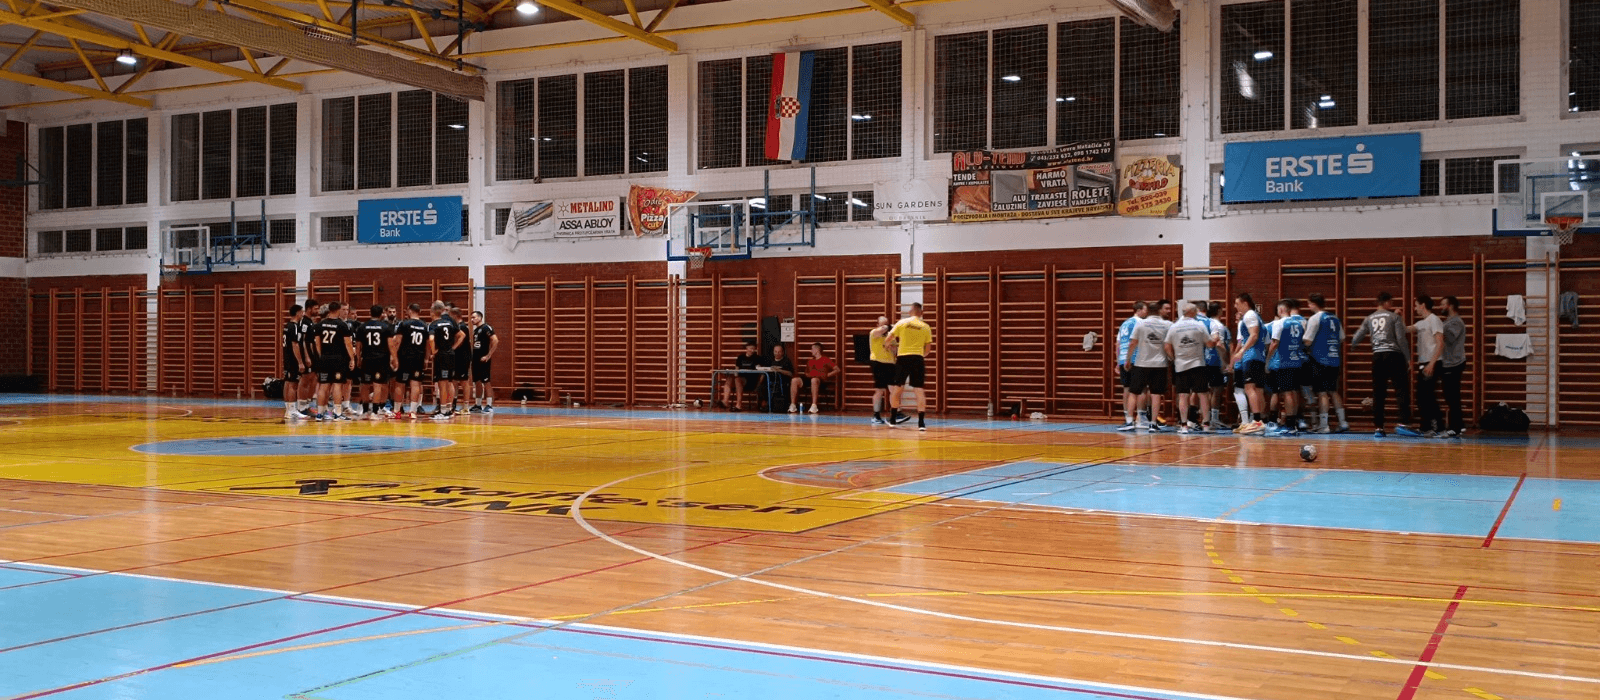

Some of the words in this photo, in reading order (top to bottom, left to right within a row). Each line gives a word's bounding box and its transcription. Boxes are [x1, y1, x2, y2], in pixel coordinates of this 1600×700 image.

[953, 151, 1026, 171] ALU-TEND
[1266, 154, 1343, 178] ERSTE
[1124, 158, 1175, 179] PIZZERIA
[953, 173, 976, 181] TENDE
[1036, 171, 1066, 180] HARMO
[1041, 179, 1067, 188] VRATA
[1266, 179, 1303, 193] Bank
[1030, 192, 1067, 201] TRAKASTE
[1072, 187, 1110, 199] ROLETE
[570, 201, 614, 214] METALIND
[898, 201, 943, 209] GARDENS
[993, 202, 1027, 210] ŽALUZINE
[1071, 198, 1098, 206] VANJSKE
[380, 210, 421, 226] ERSTE
[559, 220, 582, 230] ASSA
[584, 218, 614, 229] ABLOY
[641, 213, 664, 222] Pizza
[380, 228, 400, 237] Bank
[1329, 320, 1336, 332] 4
[1371, 317, 1386, 332] 99
[322, 330, 336, 344] 27
[410, 331, 423, 345] 10
[443, 327, 450, 340] 3
[1290, 325, 1300, 338] 45
[366, 332, 381, 346] 13
[338, 494, 616, 515] BANK
